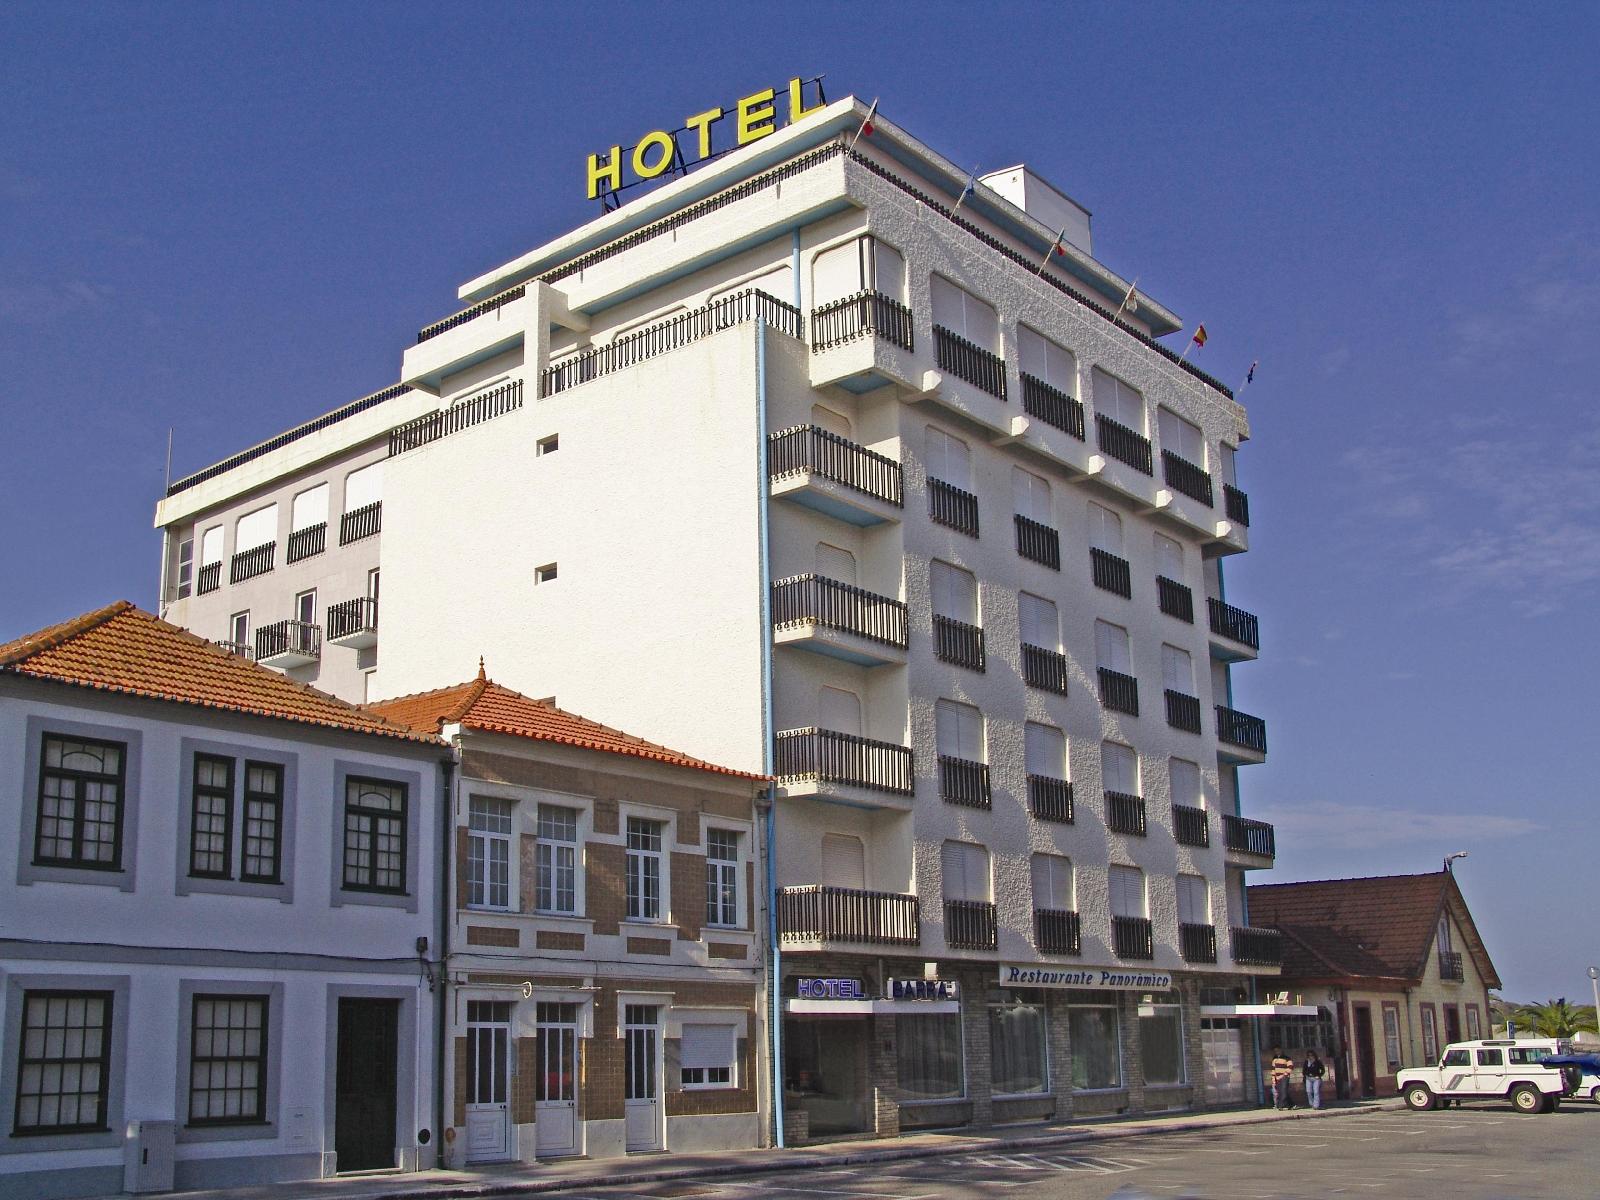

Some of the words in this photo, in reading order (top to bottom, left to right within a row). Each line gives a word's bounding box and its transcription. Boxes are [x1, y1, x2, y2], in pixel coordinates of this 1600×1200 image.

[586, 77, 827, 200] HOTEL
[1007, 966, 1093, 985] Restaurante
[798, 978, 865, 998] HOTEL
[893, 980, 947, 999] BARRA
